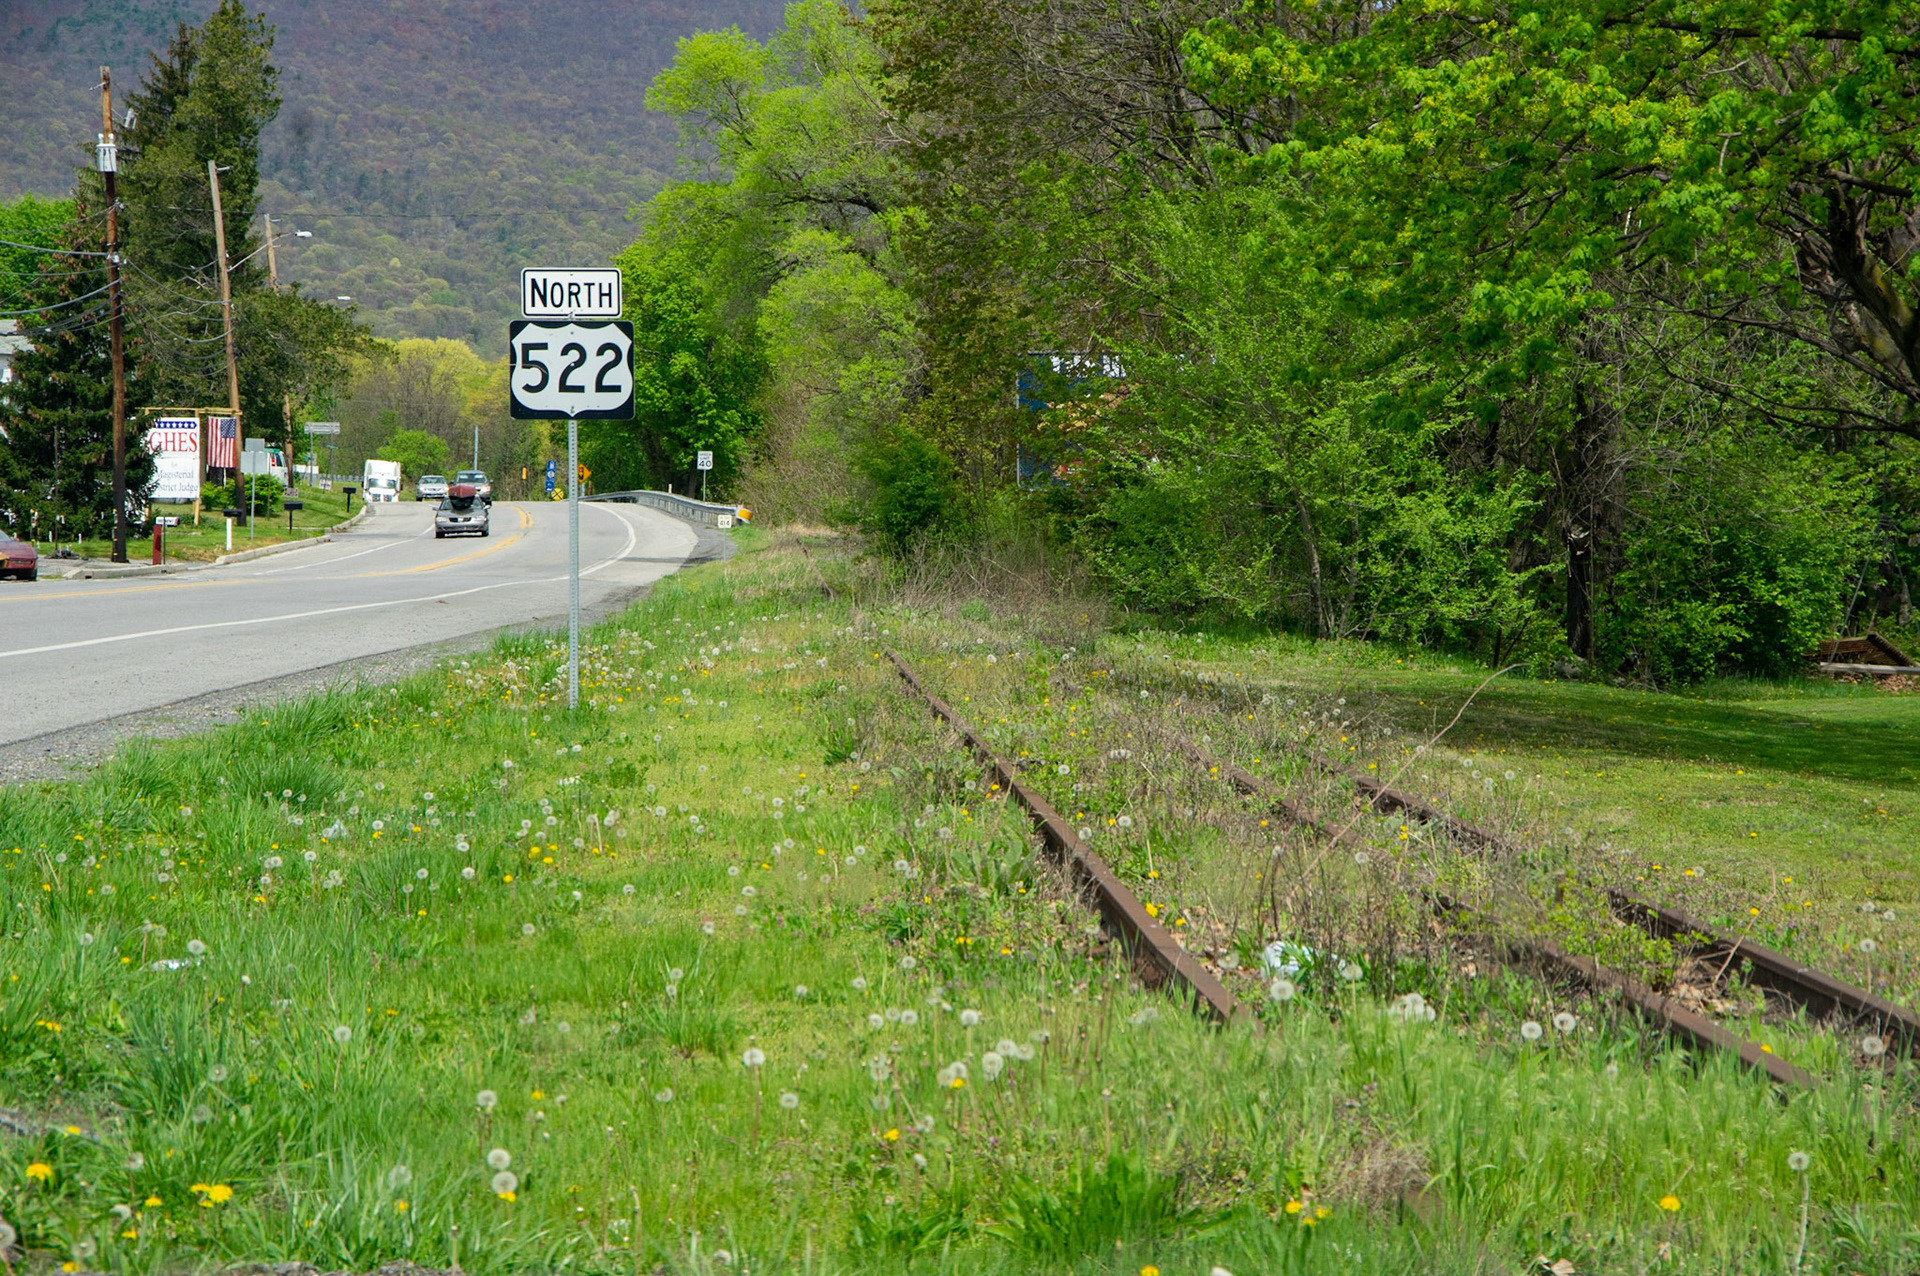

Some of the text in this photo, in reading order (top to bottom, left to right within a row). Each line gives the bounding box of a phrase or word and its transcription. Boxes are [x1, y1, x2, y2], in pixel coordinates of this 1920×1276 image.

[530, 277, 612, 309] NORTH
[521, 342, 623, 394] 522
[149, 431, 198, 453] GHES
[699, 460, 712, 468] 40
[179, 482, 199, 494] Judge
